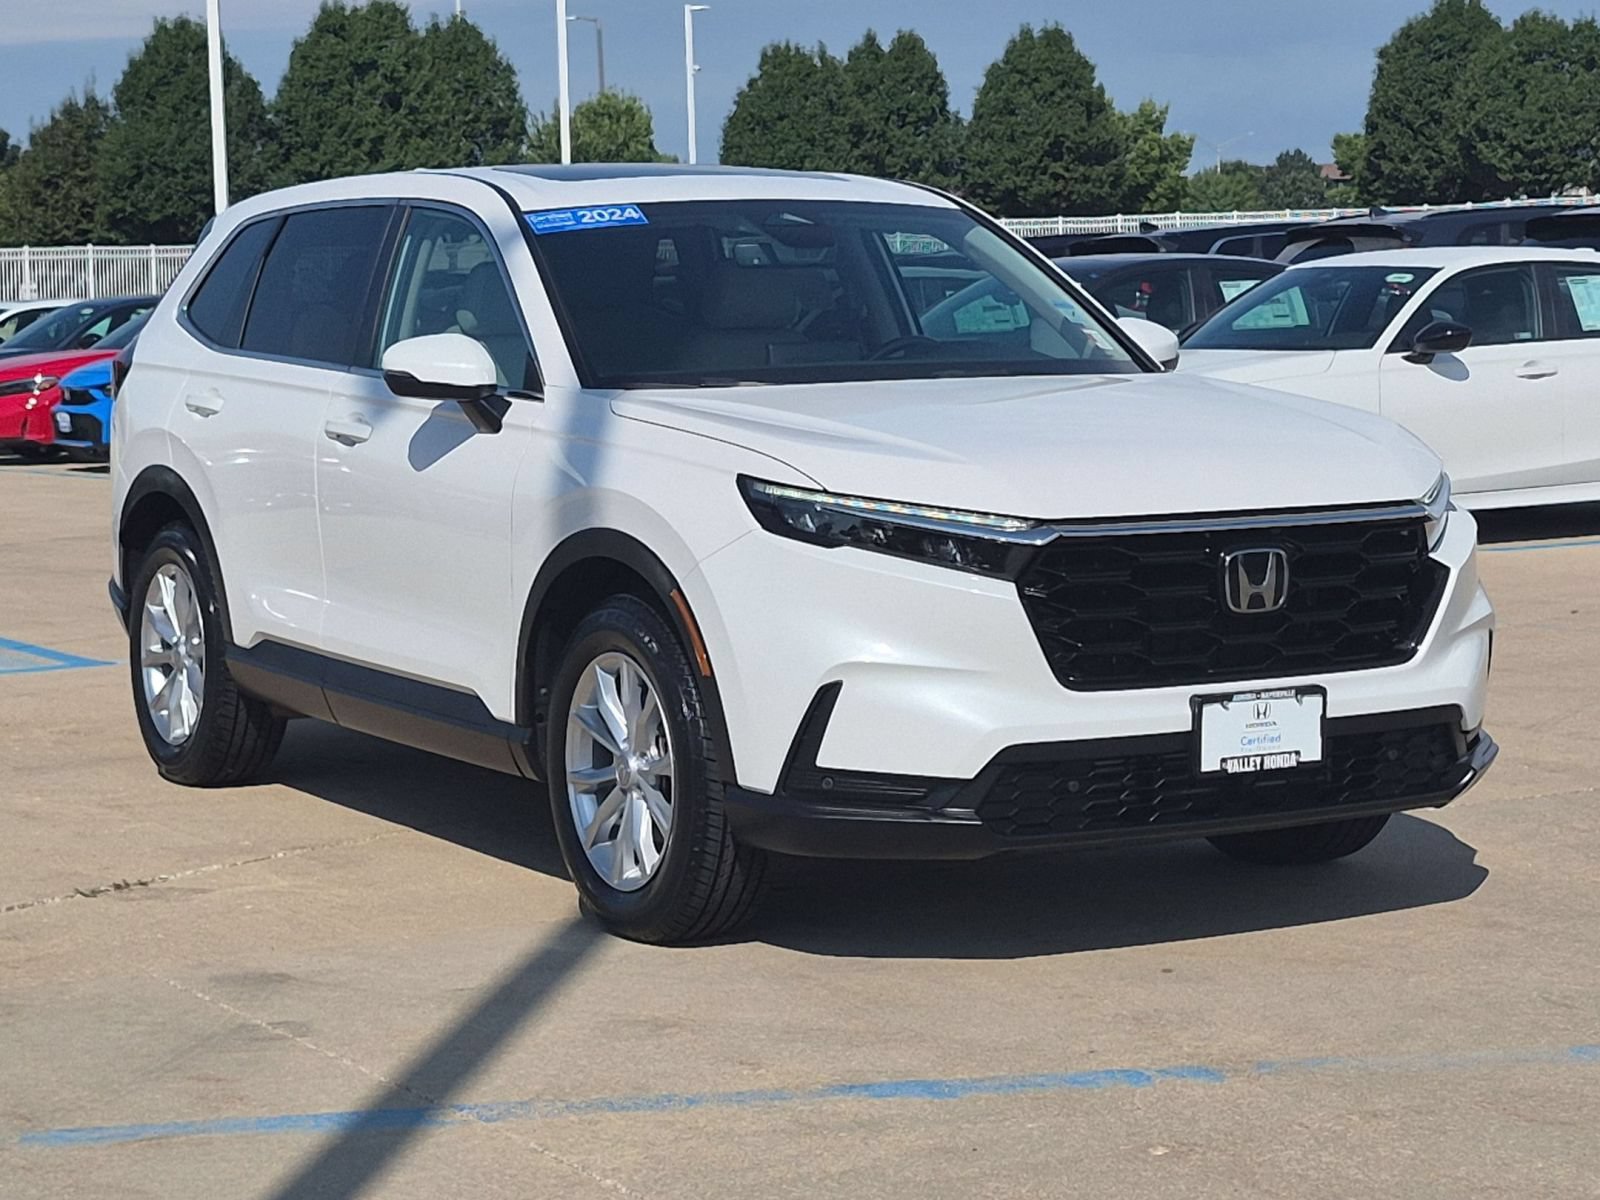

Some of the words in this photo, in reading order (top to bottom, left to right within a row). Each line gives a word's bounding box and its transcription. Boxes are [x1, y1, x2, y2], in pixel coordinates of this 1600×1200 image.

[577, 208, 640, 223] 2024
[1240, 734, 1281, 746] Certified
[1227, 757, 1262, 774] VALLEY
[1263, 753, 1298, 770] HONDA
